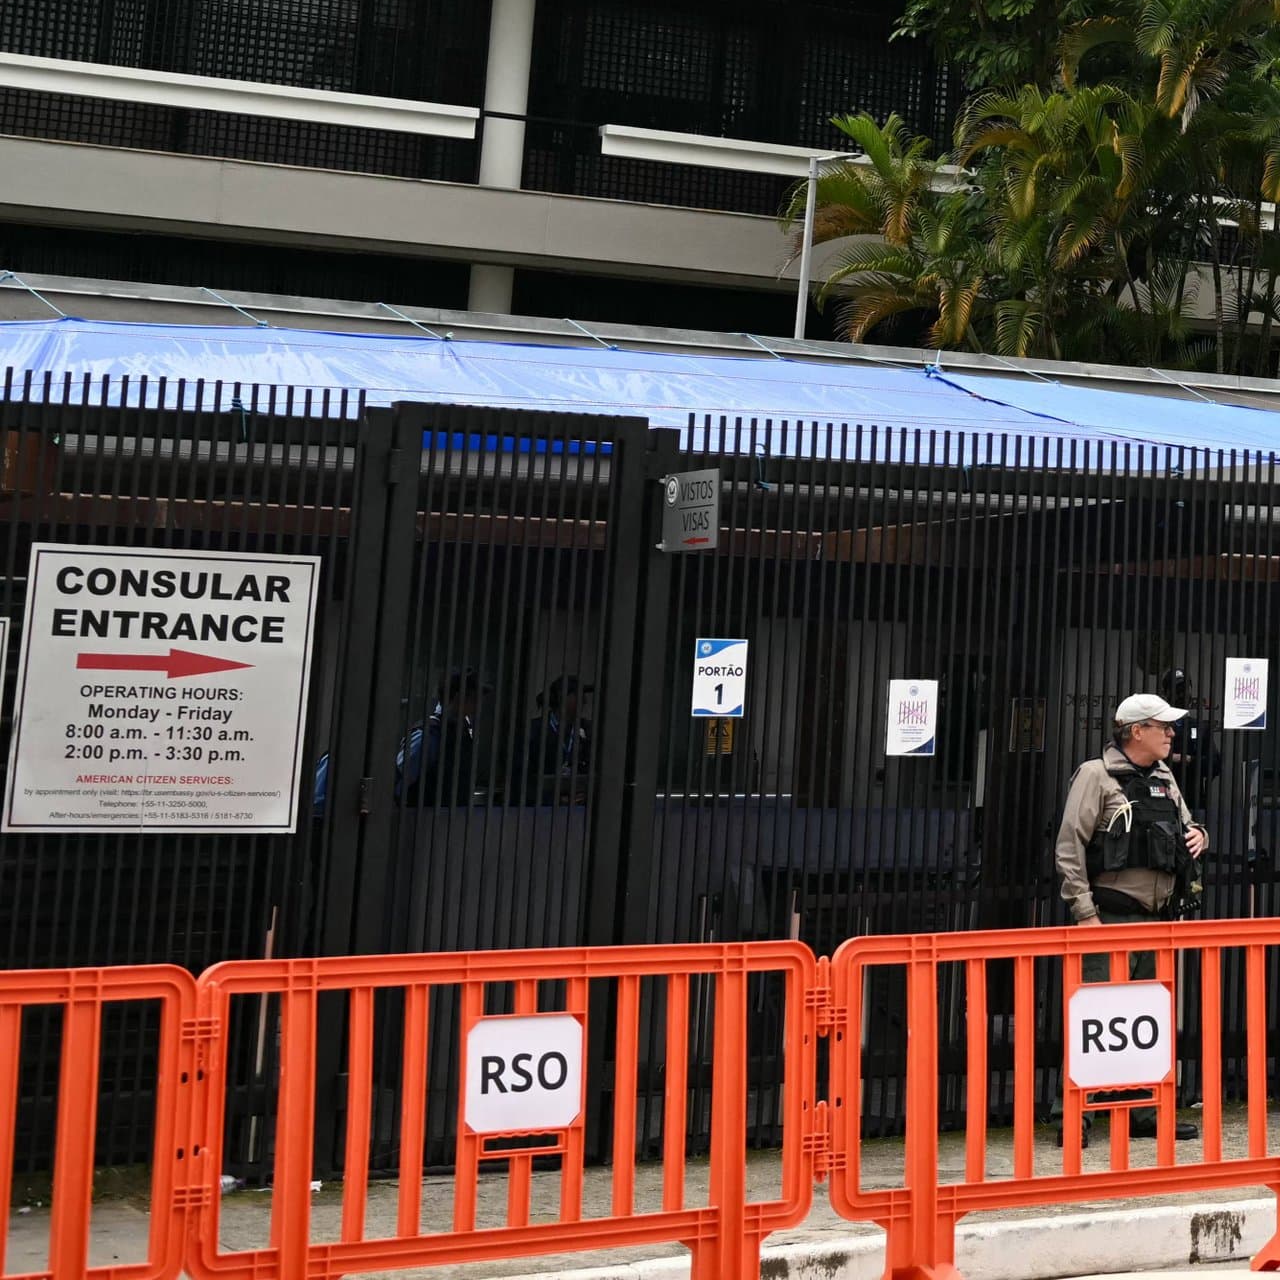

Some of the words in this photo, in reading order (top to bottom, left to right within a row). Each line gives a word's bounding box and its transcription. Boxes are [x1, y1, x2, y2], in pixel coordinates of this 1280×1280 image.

[680, 480, 713, 501] VISTOS
[682, 511, 710, 532] VISAS
[56, 566, 290, 602] CONSULAR
[51, 608, 285, 643] ENTRANCE
[698, 664, 744, 676] PORTÃO
[80, 685, 177, 700] OPERATING
[182, 688, 244, 700] HOURS:
[714, 683, 723, 705] 1
[88, 704, 160, 723] Monday
[177, 706, 232, 724] Friday
[65, 724, 104, 739] 8:00
[110, 728, 147, 740] a.m.
[166, 726, 213, 741] 11:30
[218, 730, 254, 741] a.m.
[64, 744, 103, 760] 2:00
[109, 748, 148, 762] p.m.
[165, 746, 203, 761] 3:30
[208, 749, 245, 764] p.m.
[76, 775, 133, 783] AMERICAN
[135, 775, 176, 784] CITIZEN
[179, 776, 234, 785] SERVICES:
[24, 788, 33, 796] by
[35, 789, 80, 797] appointment
[82, 789, 98, 797] only
[1082, 1015, 1159, 1054] RSO
[481, 1051, 568, 1095] RSO
